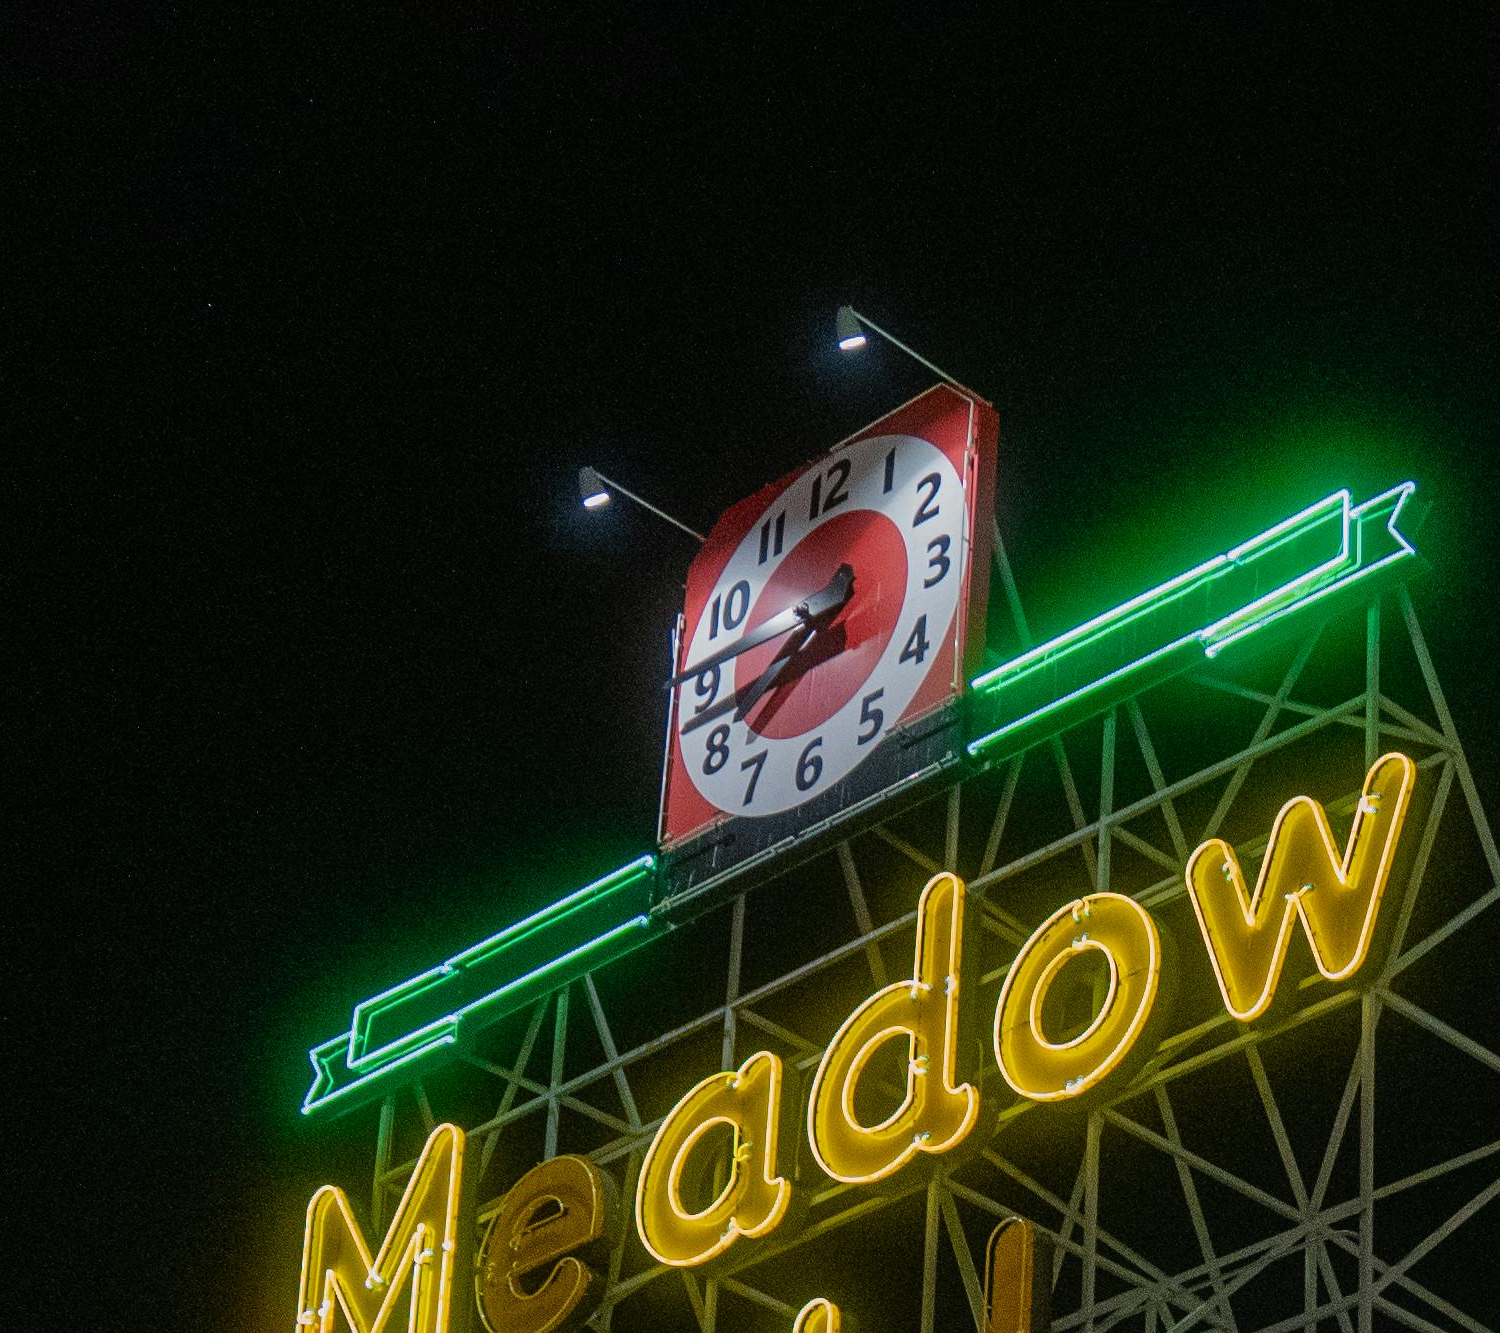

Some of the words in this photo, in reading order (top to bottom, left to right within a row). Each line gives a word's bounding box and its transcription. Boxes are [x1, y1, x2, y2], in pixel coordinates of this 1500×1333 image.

[809, 458, 852, 521] 12
[883, 447, 896, 495] 1
[912, 472, 942, 527] 2
[758, 511, 786, 565] 11
[923, 534, 951, 588] 3
[708, 580, 751, 640] 10
[899, 614, 930, 664] 4
[694, 662, 721, 714] 9
[857, 687, 884, 745] 5
[702, 723, 730, 775] 8
[795, 736, 823, 791] 6
[740, 749, 767, 806] 7
